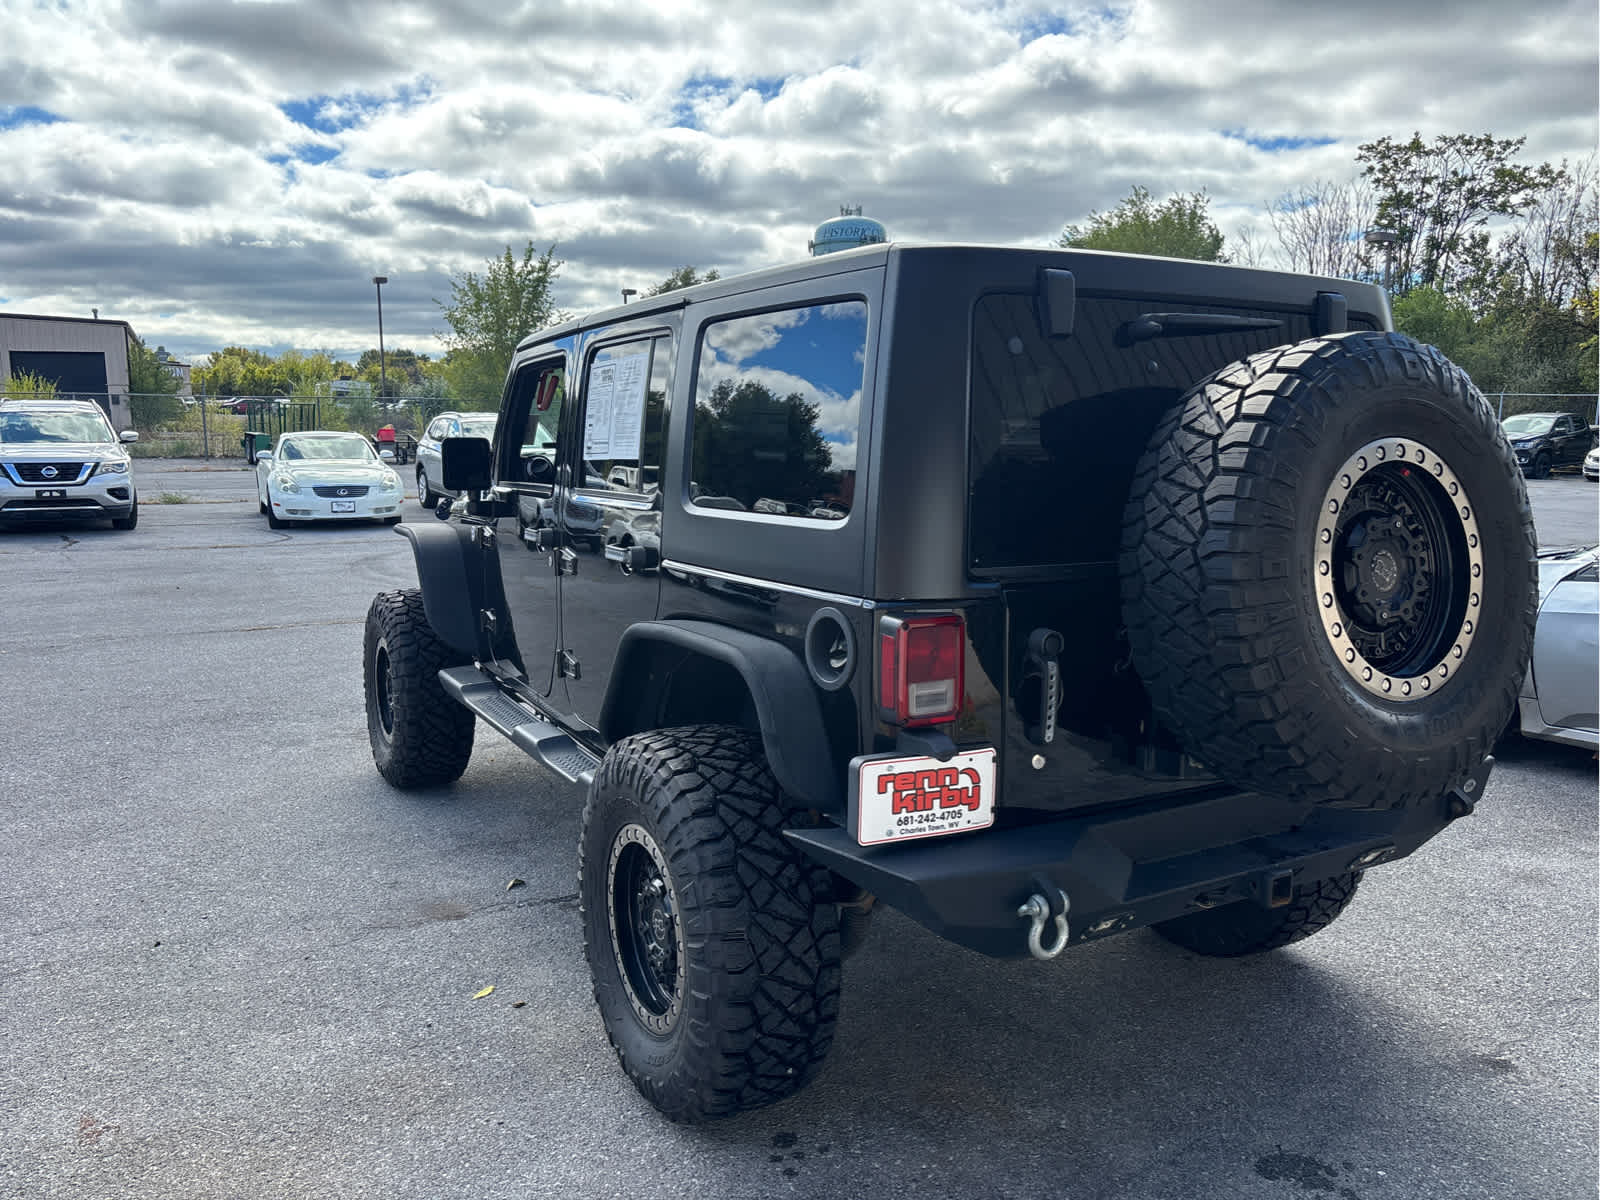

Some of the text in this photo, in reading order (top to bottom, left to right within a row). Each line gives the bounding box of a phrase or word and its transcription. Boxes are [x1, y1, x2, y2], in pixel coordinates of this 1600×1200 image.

[877, 767, 959, 795] renn
[896, 809, 963, 827] 681-242-4705
[899, 827, 926, 835] Charles
